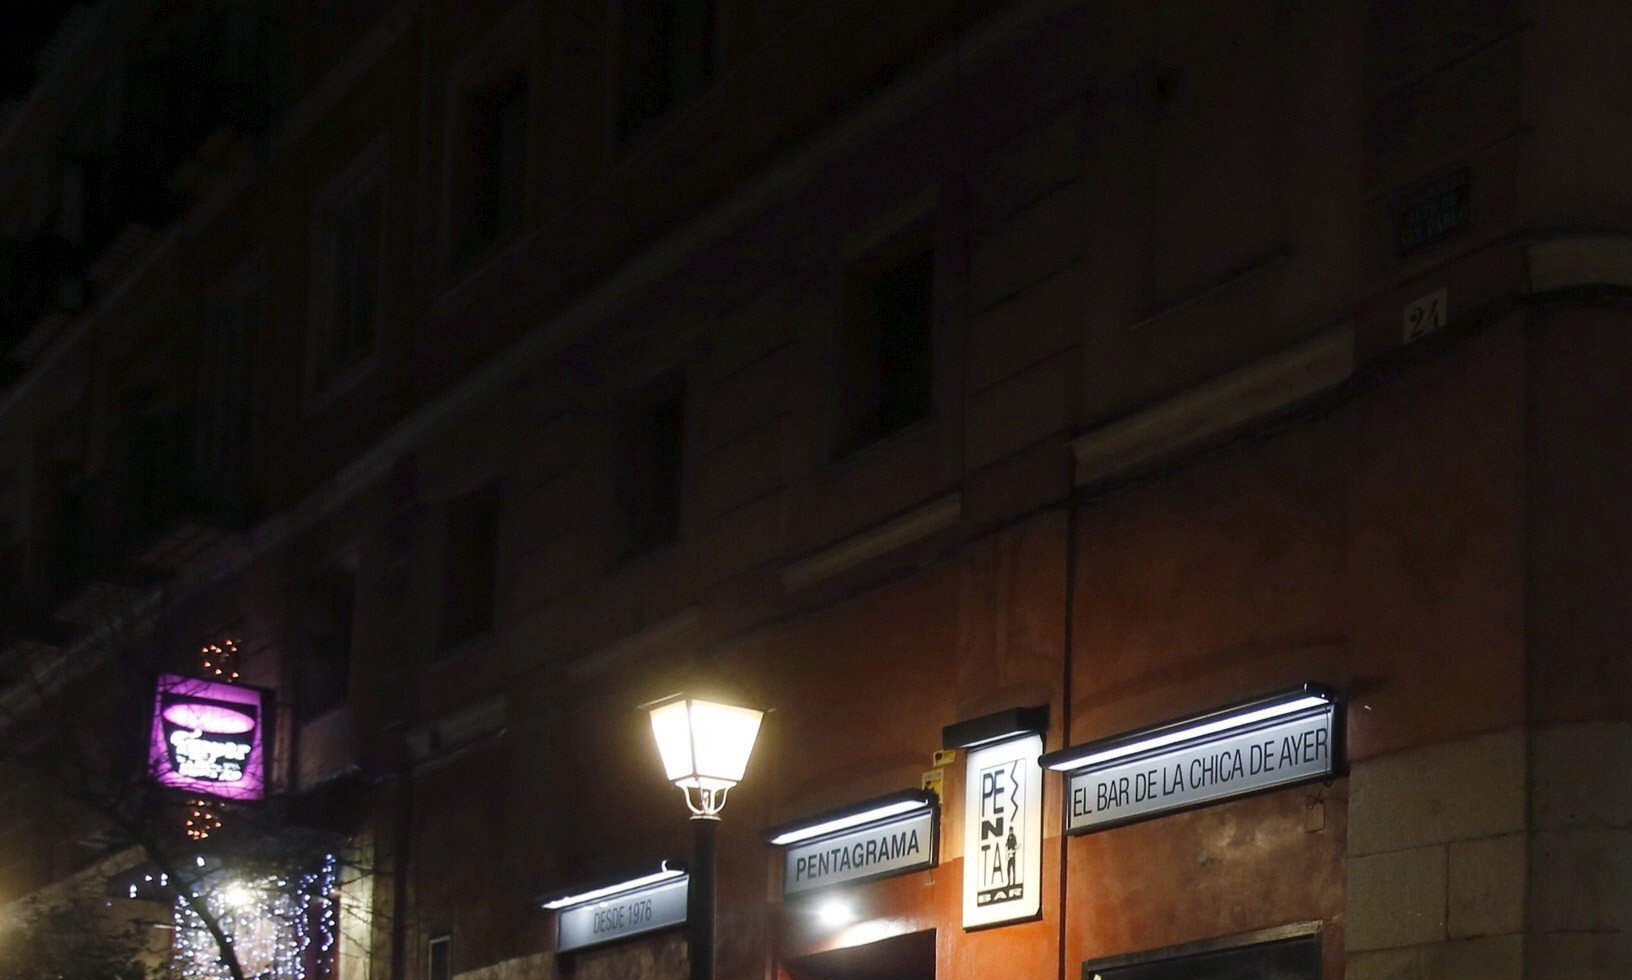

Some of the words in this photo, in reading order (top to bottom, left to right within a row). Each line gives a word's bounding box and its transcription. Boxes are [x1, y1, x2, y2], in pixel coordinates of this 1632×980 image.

[1073, 787, 1092, 818] EL
[1097, 776, 1130, 812] BAR
[1135, 769, 1158, 803] DE
[1162, 764, 1185, 796] LA
[1190, 749, 1244, 790] CHICA
[1249, 740, 1275, 776] DE
[1278, 726, 1329, 770] AYER
[796, 829, 920, 882] PENTAGRAMA
[593, 905, 625, 934] DESDE
[628, 899, 652, 925] 1976
[978, 886, 1023, 905] BAR
